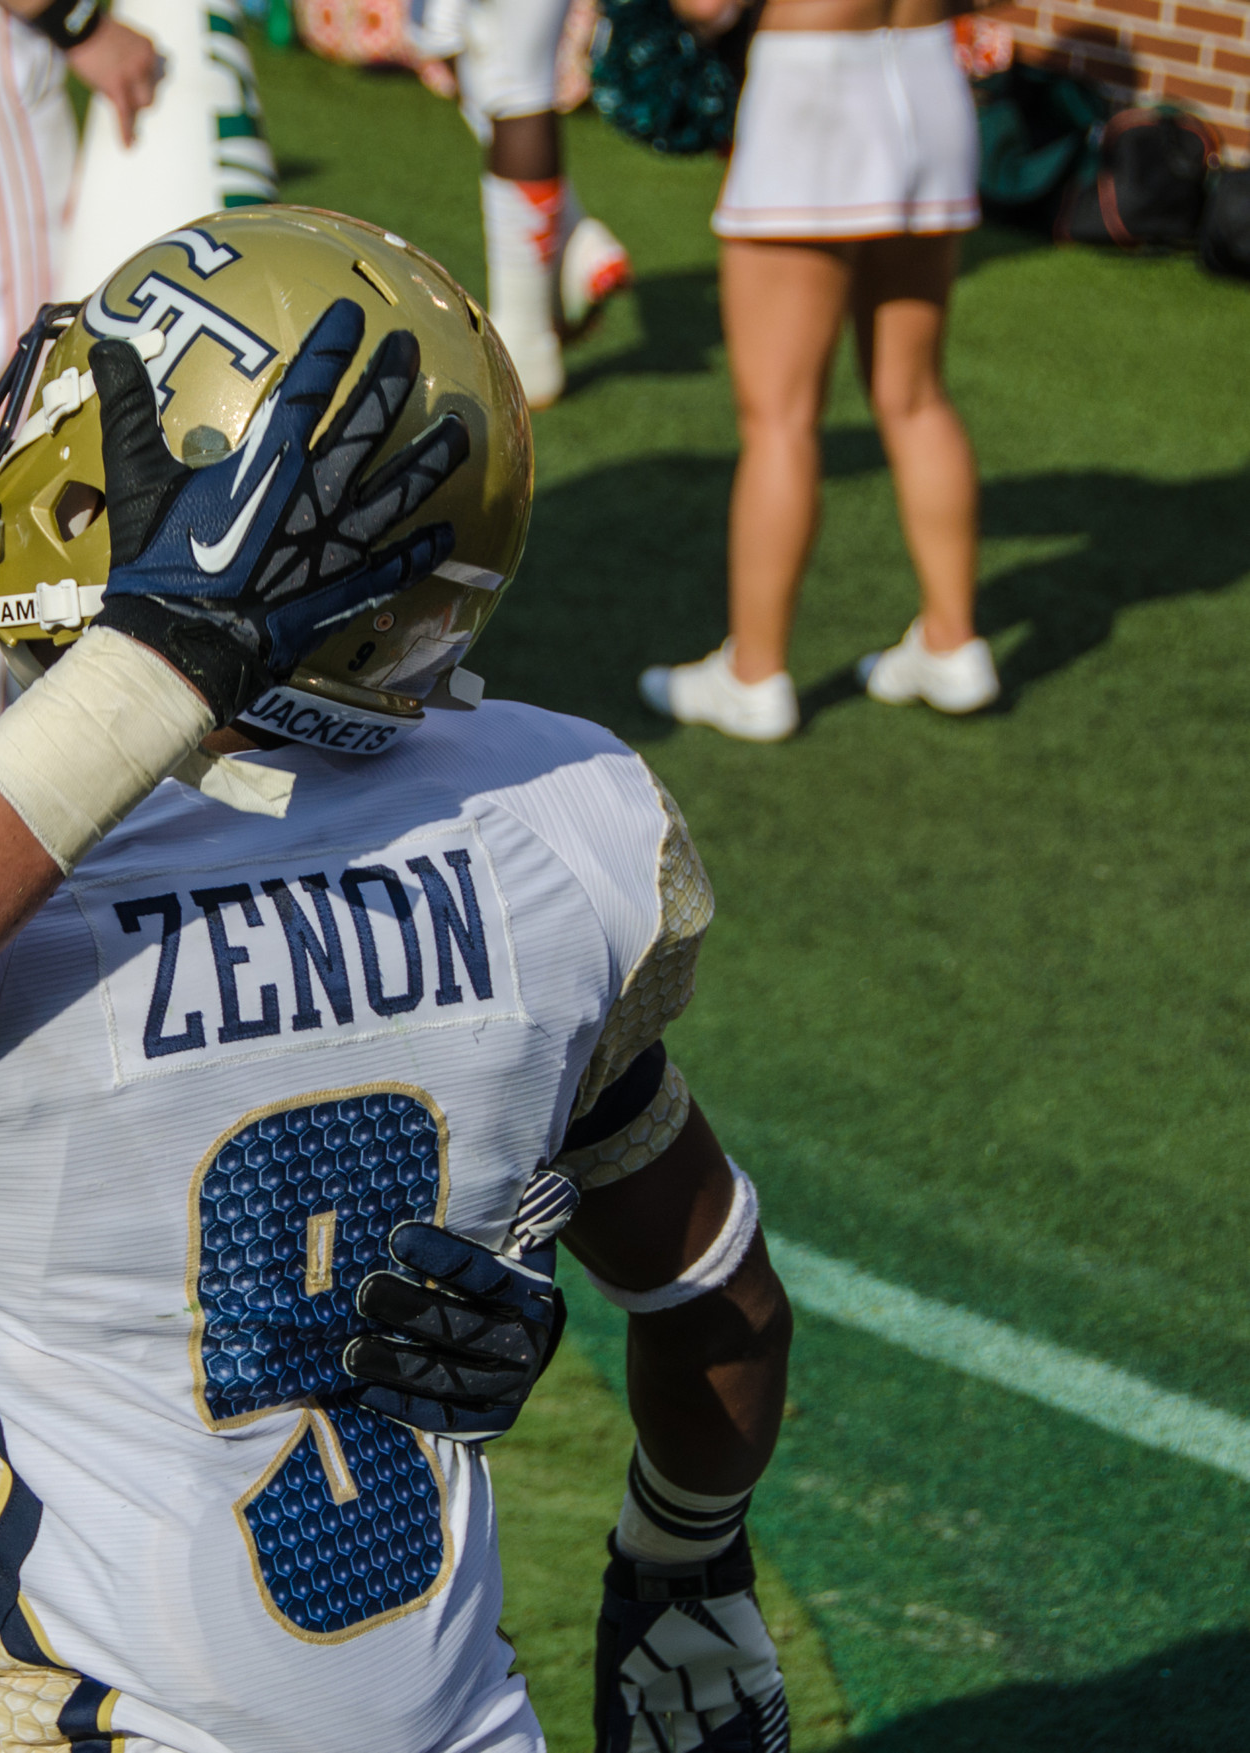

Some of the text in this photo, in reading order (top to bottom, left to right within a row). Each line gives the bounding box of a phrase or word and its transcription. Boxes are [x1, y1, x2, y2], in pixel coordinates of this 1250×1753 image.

[247, 694, 397, 751] JACKETS
[348, 641, 376, 672] 9
[112, 848, 494, 1059] ZENON
[185, 1080, 454, 1645] 9
